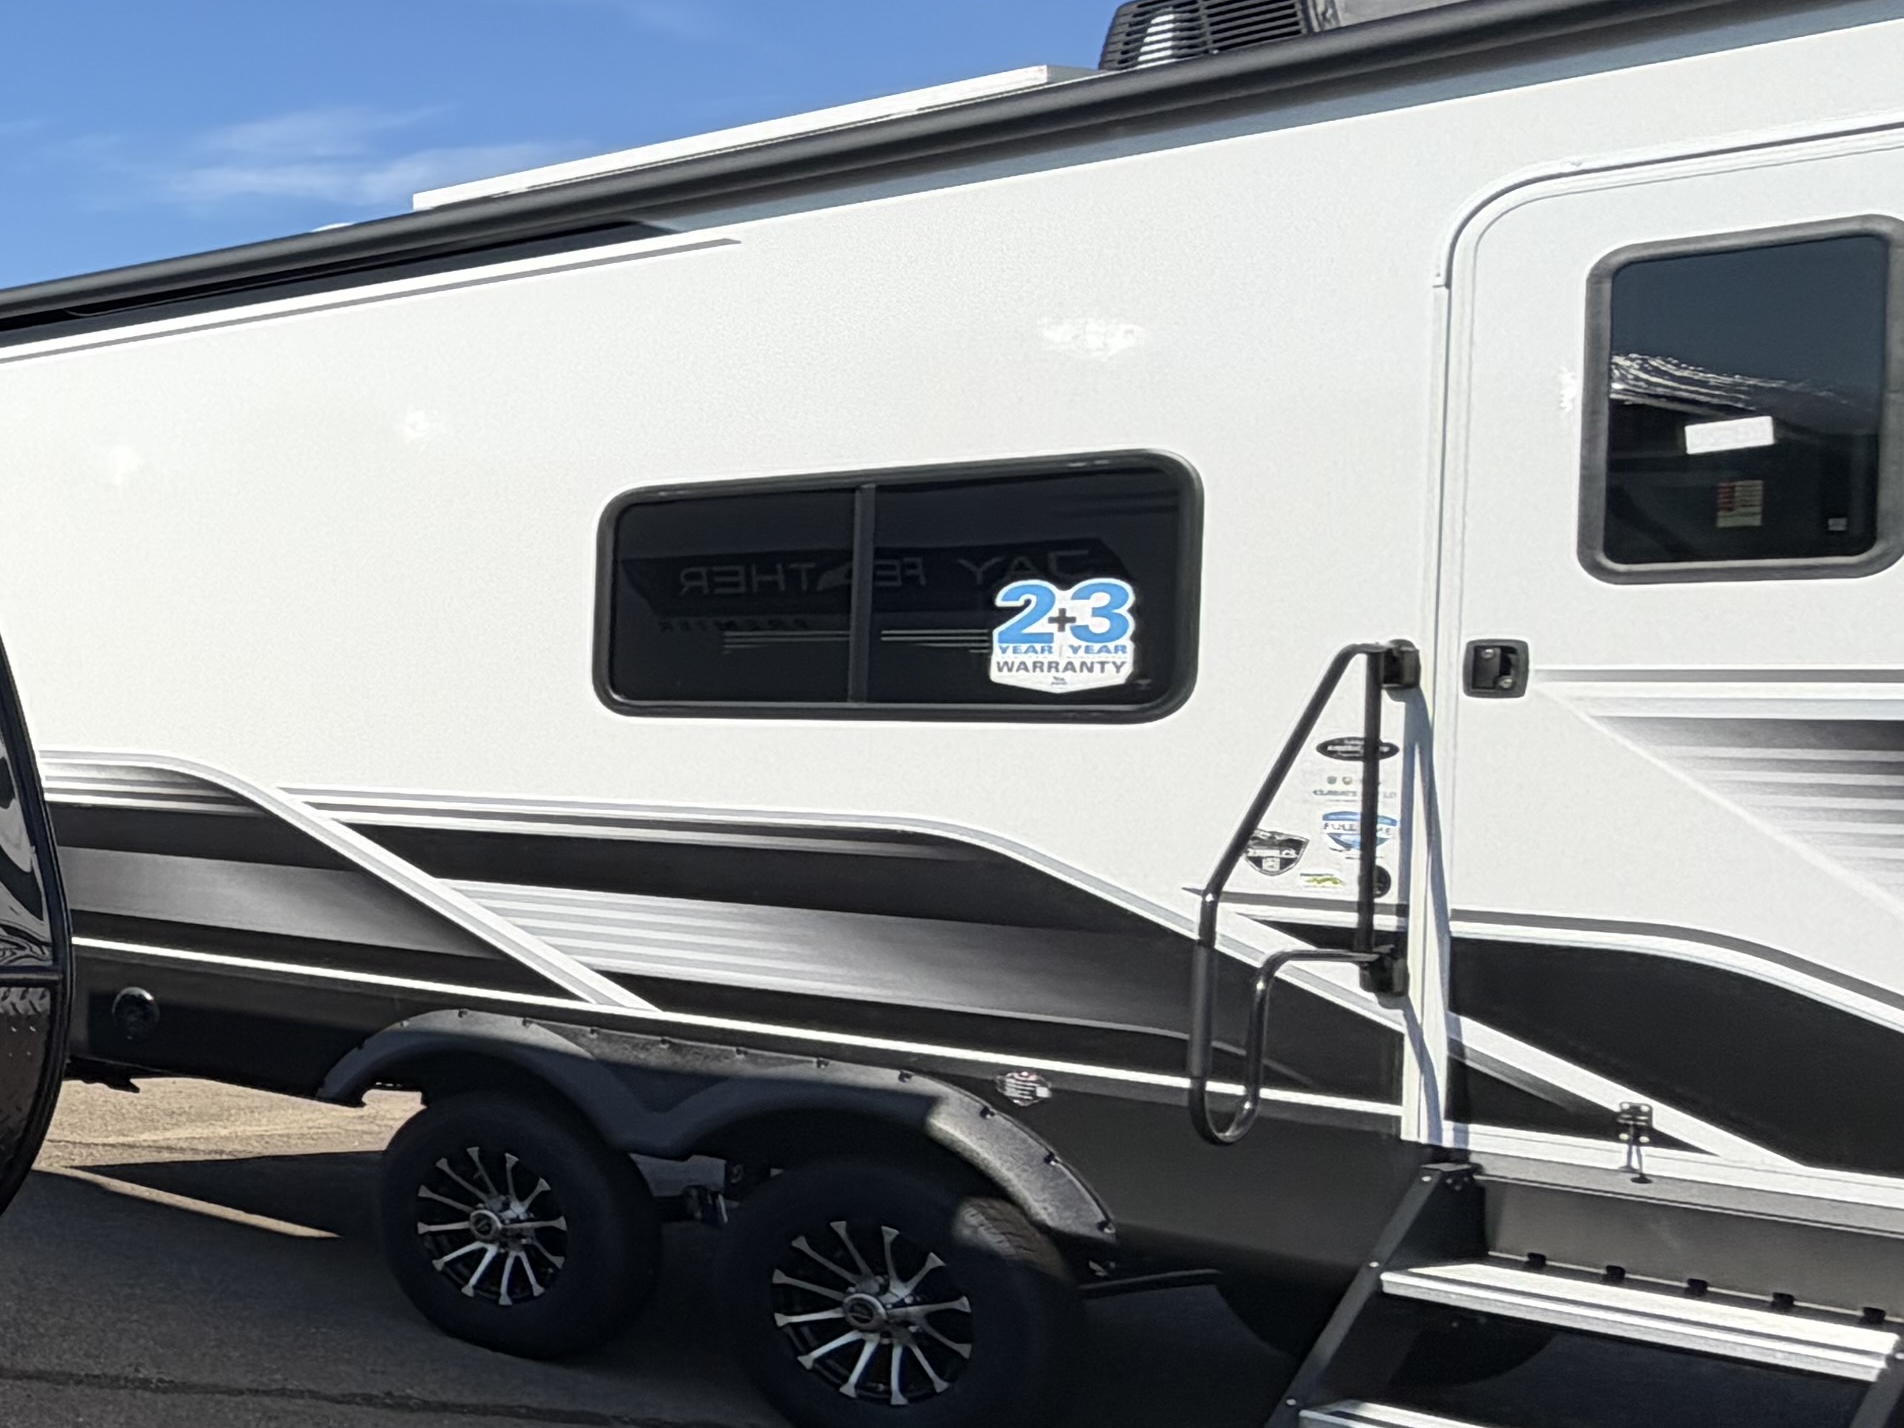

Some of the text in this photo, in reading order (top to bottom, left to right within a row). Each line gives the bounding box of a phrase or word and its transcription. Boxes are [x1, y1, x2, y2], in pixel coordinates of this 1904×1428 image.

[998, 645, 1128, 655] YEAR YEAR
[996, 661, 1128, 674] WARRANTY
